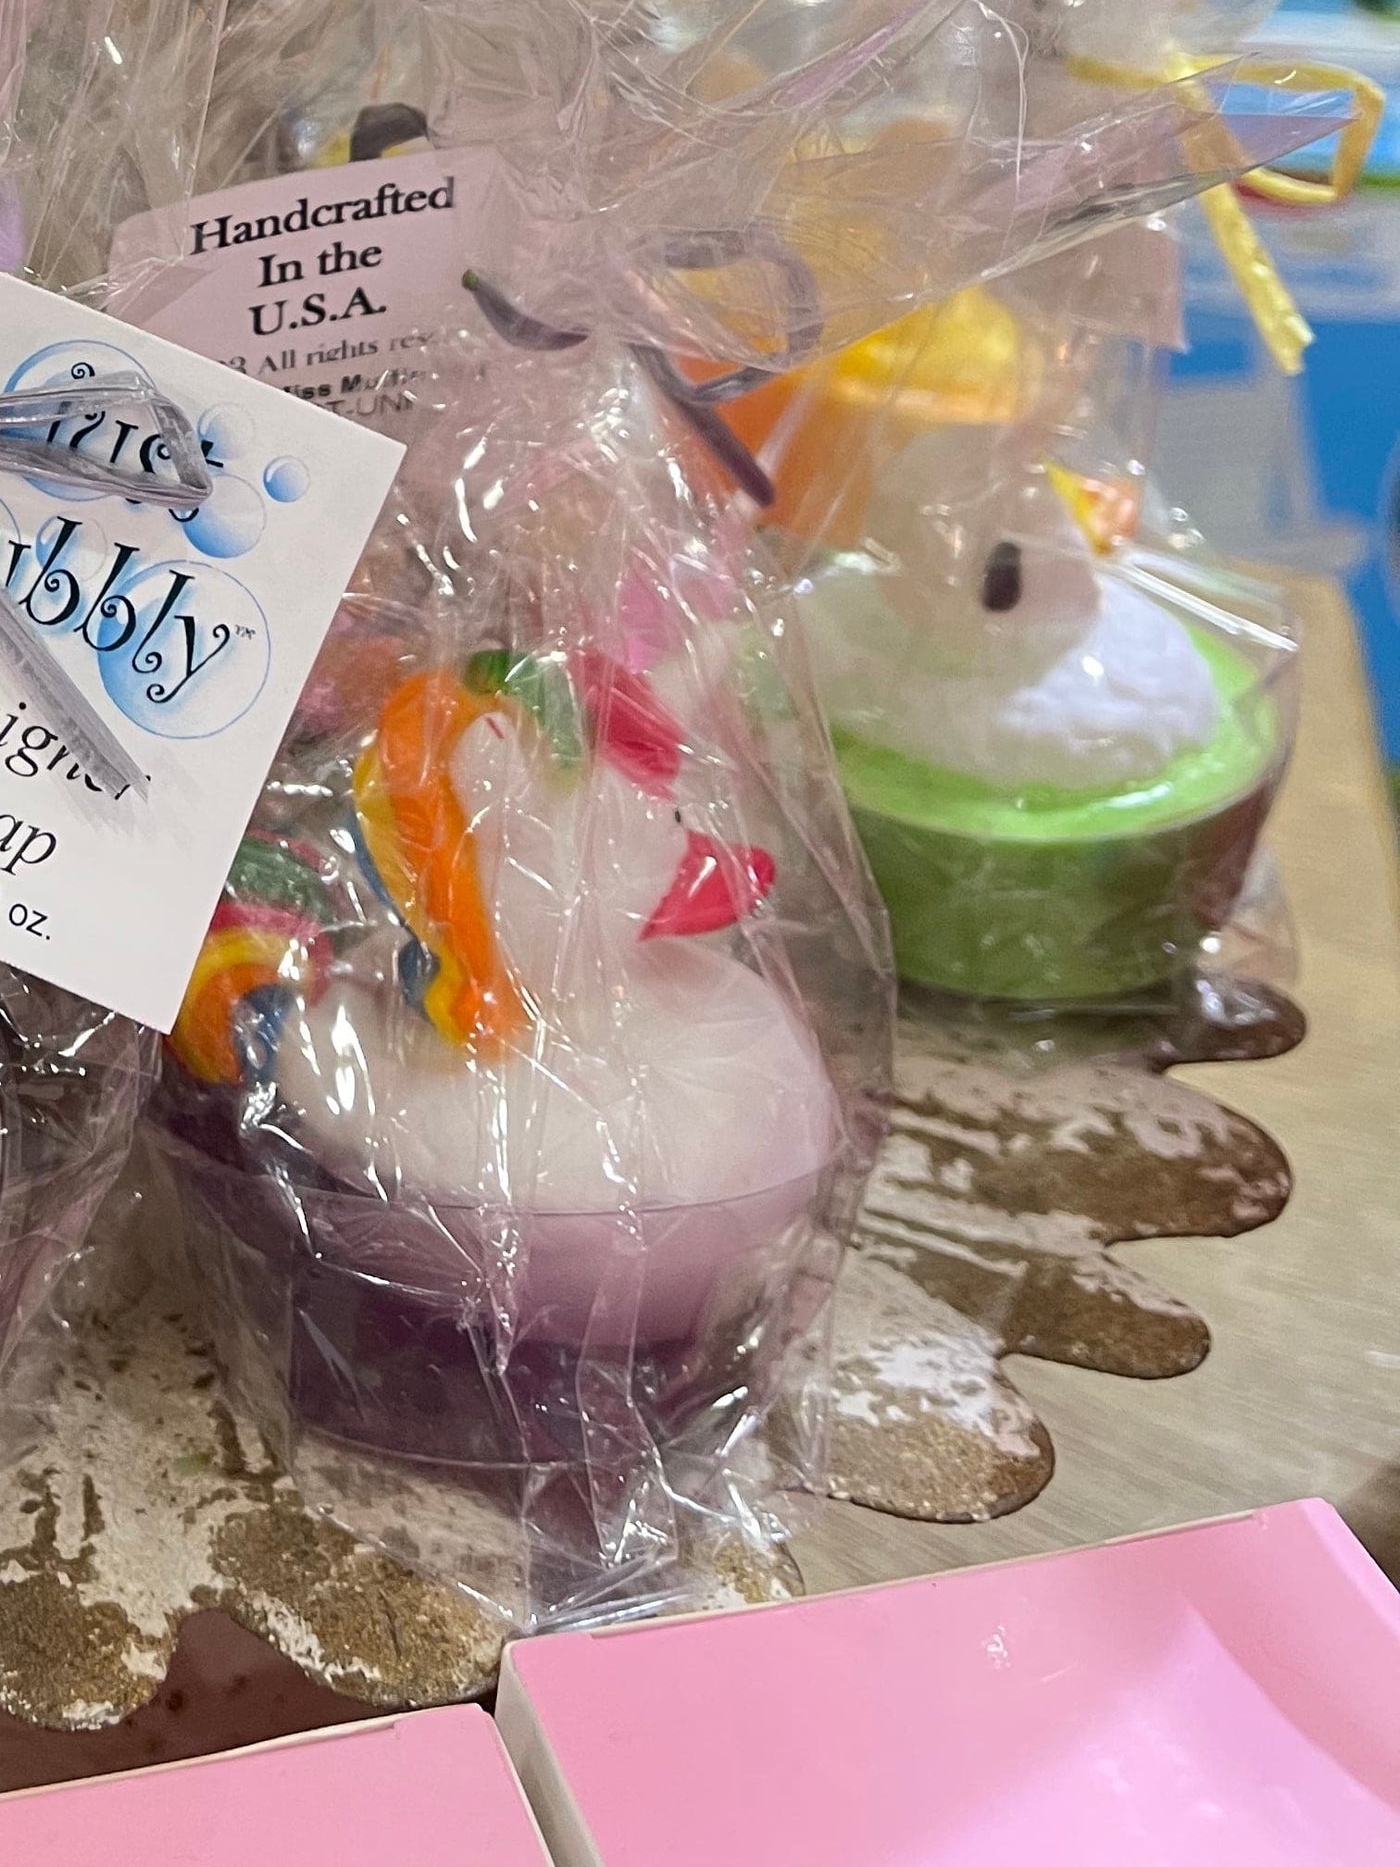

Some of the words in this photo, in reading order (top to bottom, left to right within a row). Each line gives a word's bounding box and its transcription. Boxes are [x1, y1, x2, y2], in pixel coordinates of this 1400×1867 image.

[190, 175, 455, 256] Handcrafted
[258, 253, 303, 288] In
[318, 241, 382, 277] the
[247, 286, 387, 336] U.S.A.
[257, 349, 297, 375] All
[306, 339, 379, 367] rights
[8, 903, 52, 941] oz.
